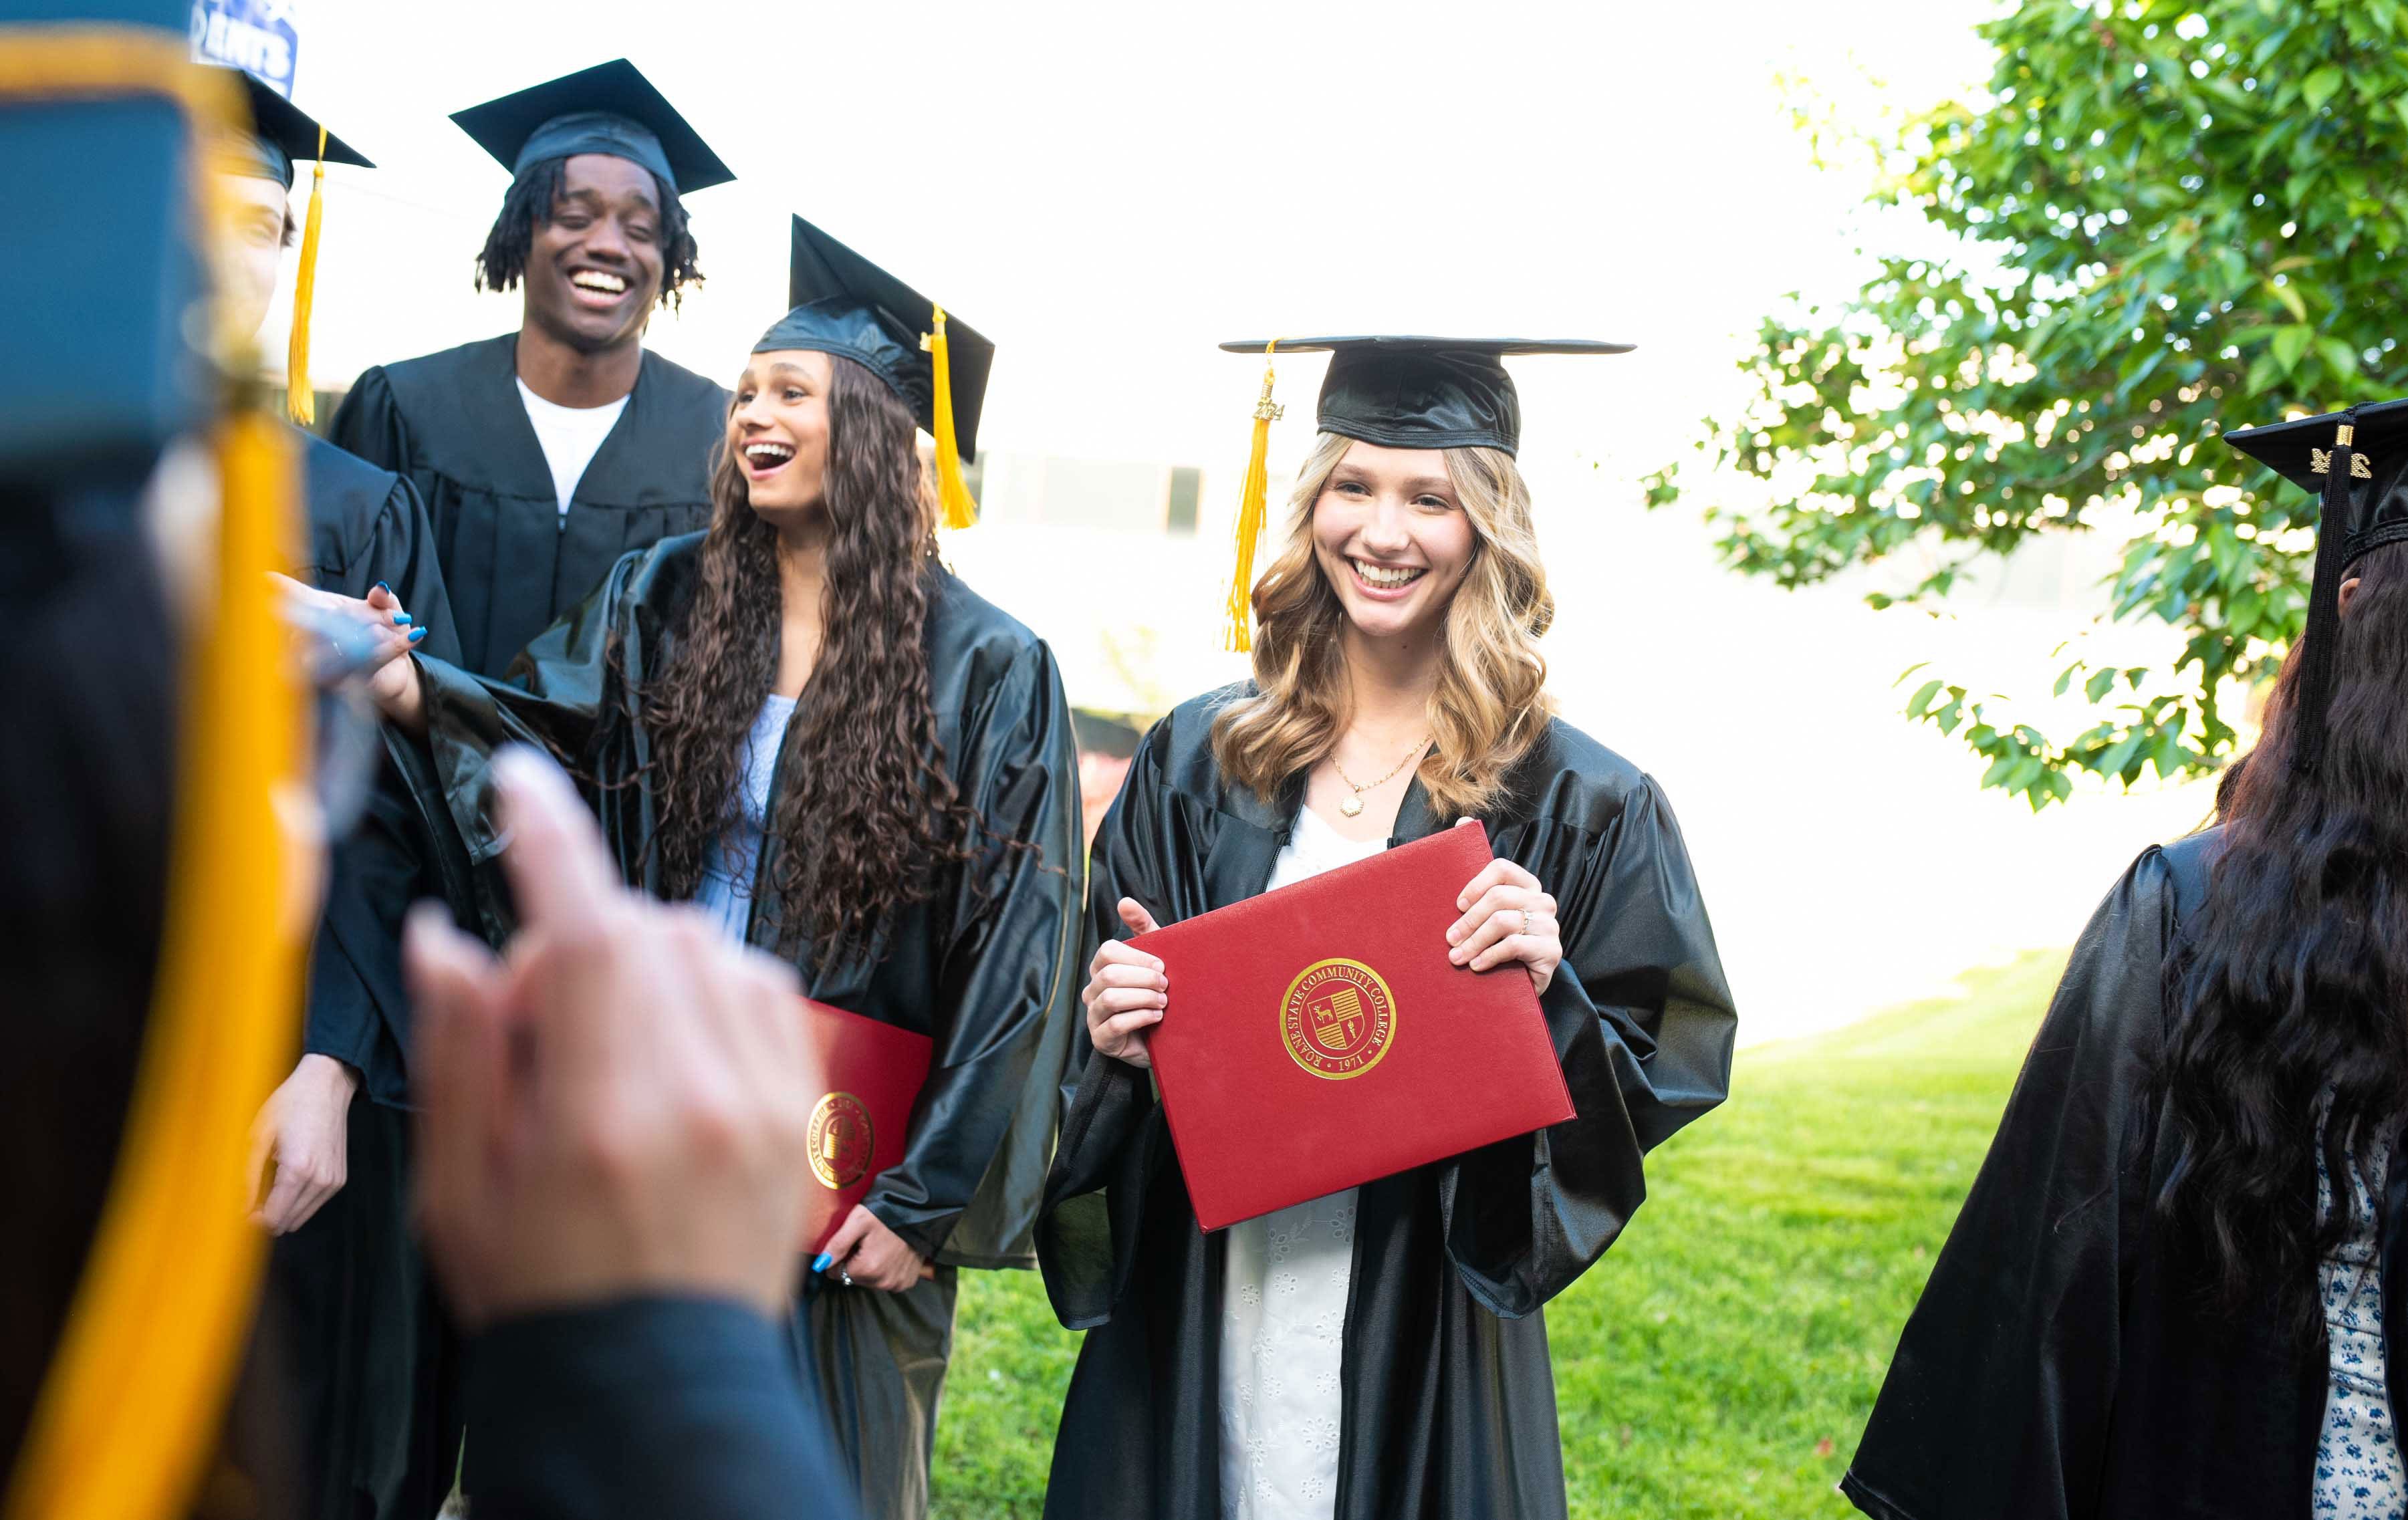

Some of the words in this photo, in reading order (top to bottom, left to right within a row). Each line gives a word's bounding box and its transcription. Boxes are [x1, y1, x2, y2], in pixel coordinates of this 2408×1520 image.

[1302, 967, 1374, 991] COMMUNITY
[1288, 989, 1305, 1029] STATE
[1370, 987, 1389, 1047] COLLEGE
[1290, 1031, 1323, 1067] ROANE
[1338, 1055, 1364, 1071] 1971
